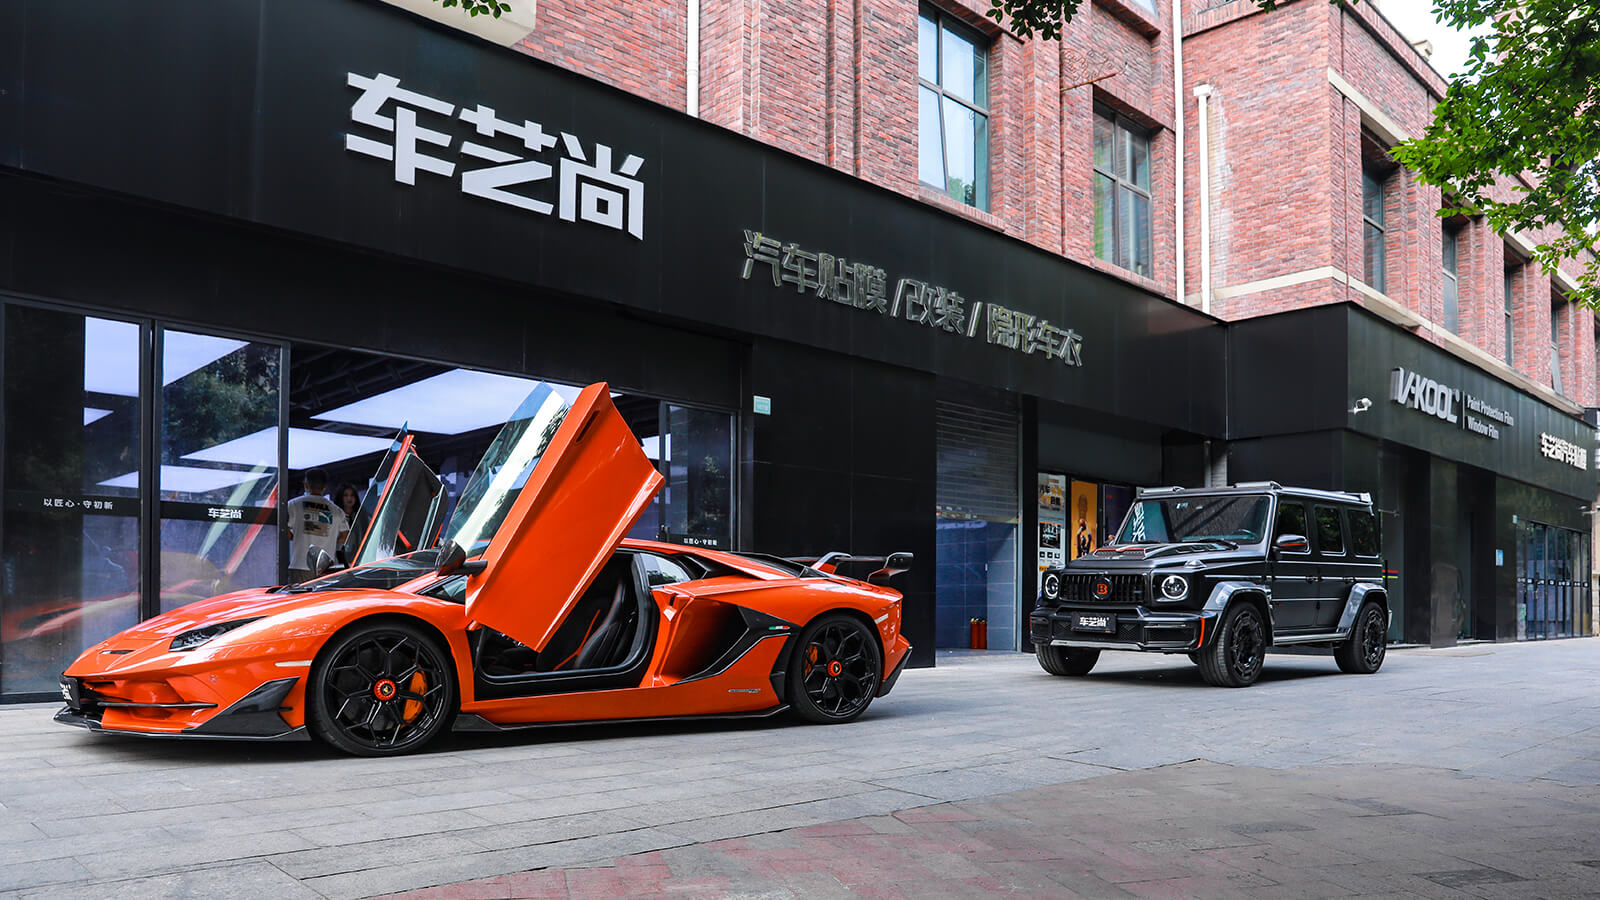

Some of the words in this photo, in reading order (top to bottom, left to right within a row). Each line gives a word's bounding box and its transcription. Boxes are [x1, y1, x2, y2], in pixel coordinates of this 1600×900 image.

[344, 71, 645, 241] 车艺尚
[1480, 400, 1504, 422] Protection
[1503, 410, 1515, 426] Film
[1467, 415, 1489, 436] Window
[1488, 423, 1499, 440] Film
[208, 507, 243, 520] 车艺尚
